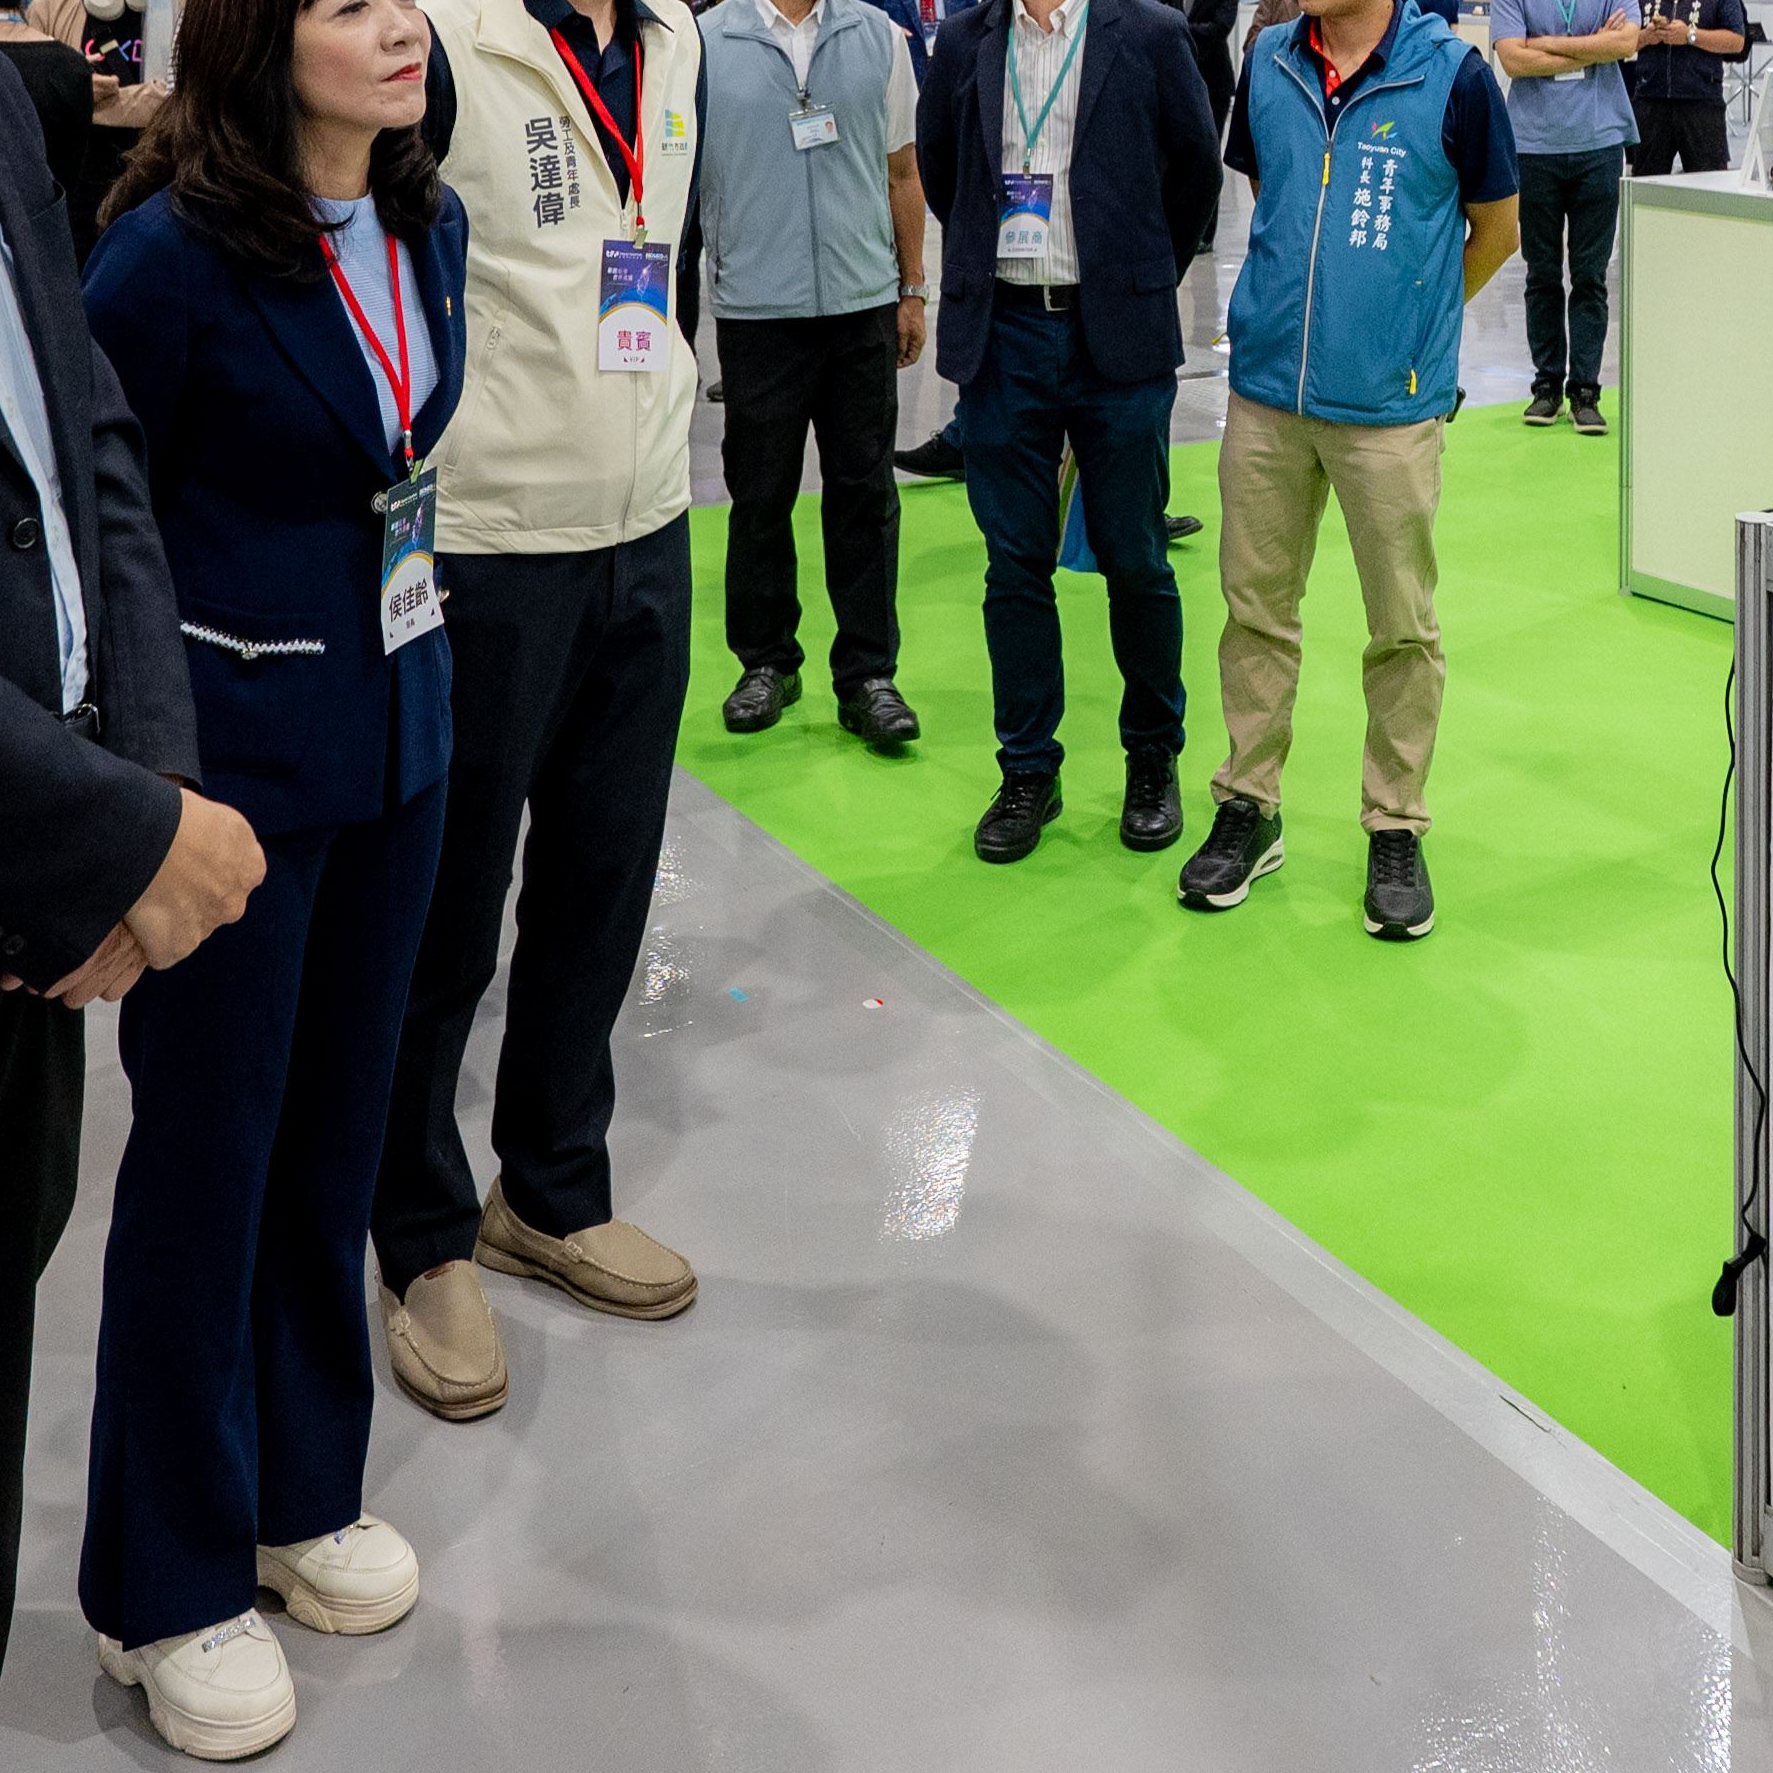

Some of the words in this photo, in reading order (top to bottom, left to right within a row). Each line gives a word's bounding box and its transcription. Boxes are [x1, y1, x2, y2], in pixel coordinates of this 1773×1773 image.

[524, 116, 566, 229] 吳達偉
[1357, 141, 1389, 154] Taoyuan
[1390, 145, 1407, 158] City
[1371, 158, 1398, 251] 青年事務局
[617, 329, 652, 351] 貴賓
[388, 577, 429, 624] 侯佳齡
